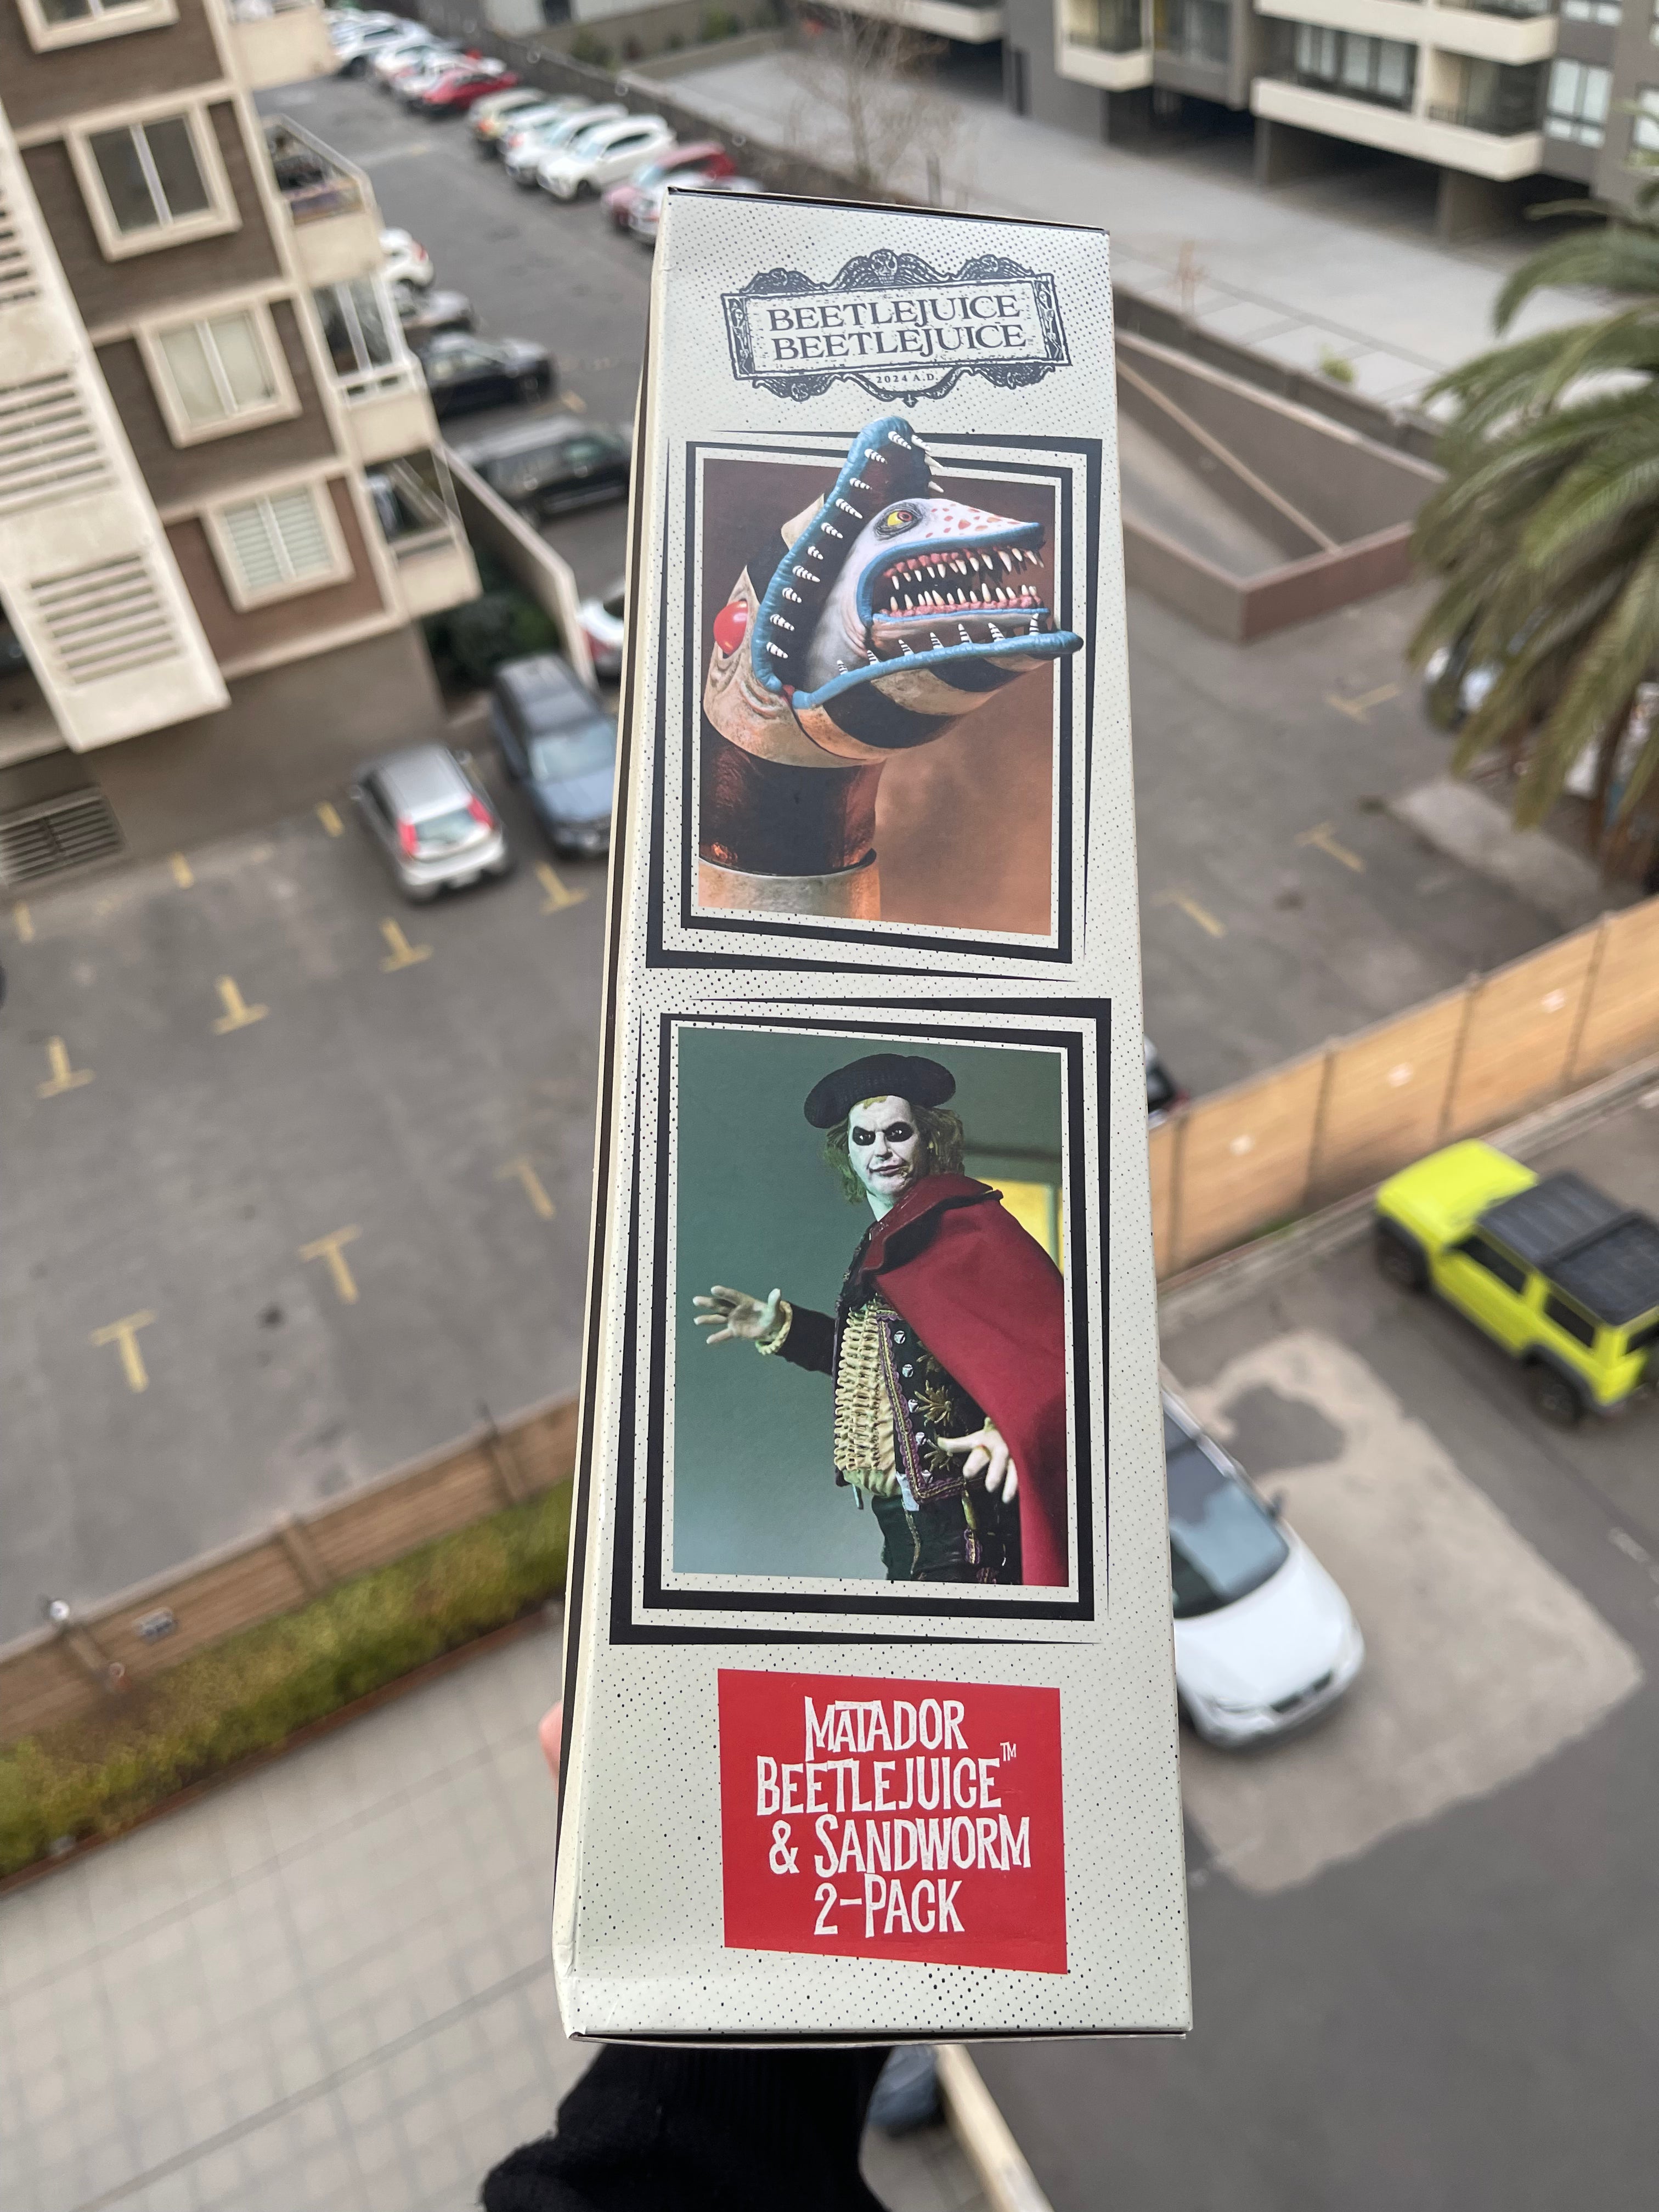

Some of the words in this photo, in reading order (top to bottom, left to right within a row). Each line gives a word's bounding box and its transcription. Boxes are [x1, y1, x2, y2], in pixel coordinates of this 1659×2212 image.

[768, 295, 1020, 331] BEETLEJUICE
[772, 325, 1026, 360] BEETLEJUICE
[876, 375, 907, 383] 2024
[805, 1696, 968, 1761] MATADOR
[769, 1820, 800, 1874] &
[814, 1814, 1031, 1878] SANDWORM
[814, 1873, 965, 1938] 2-PACK
